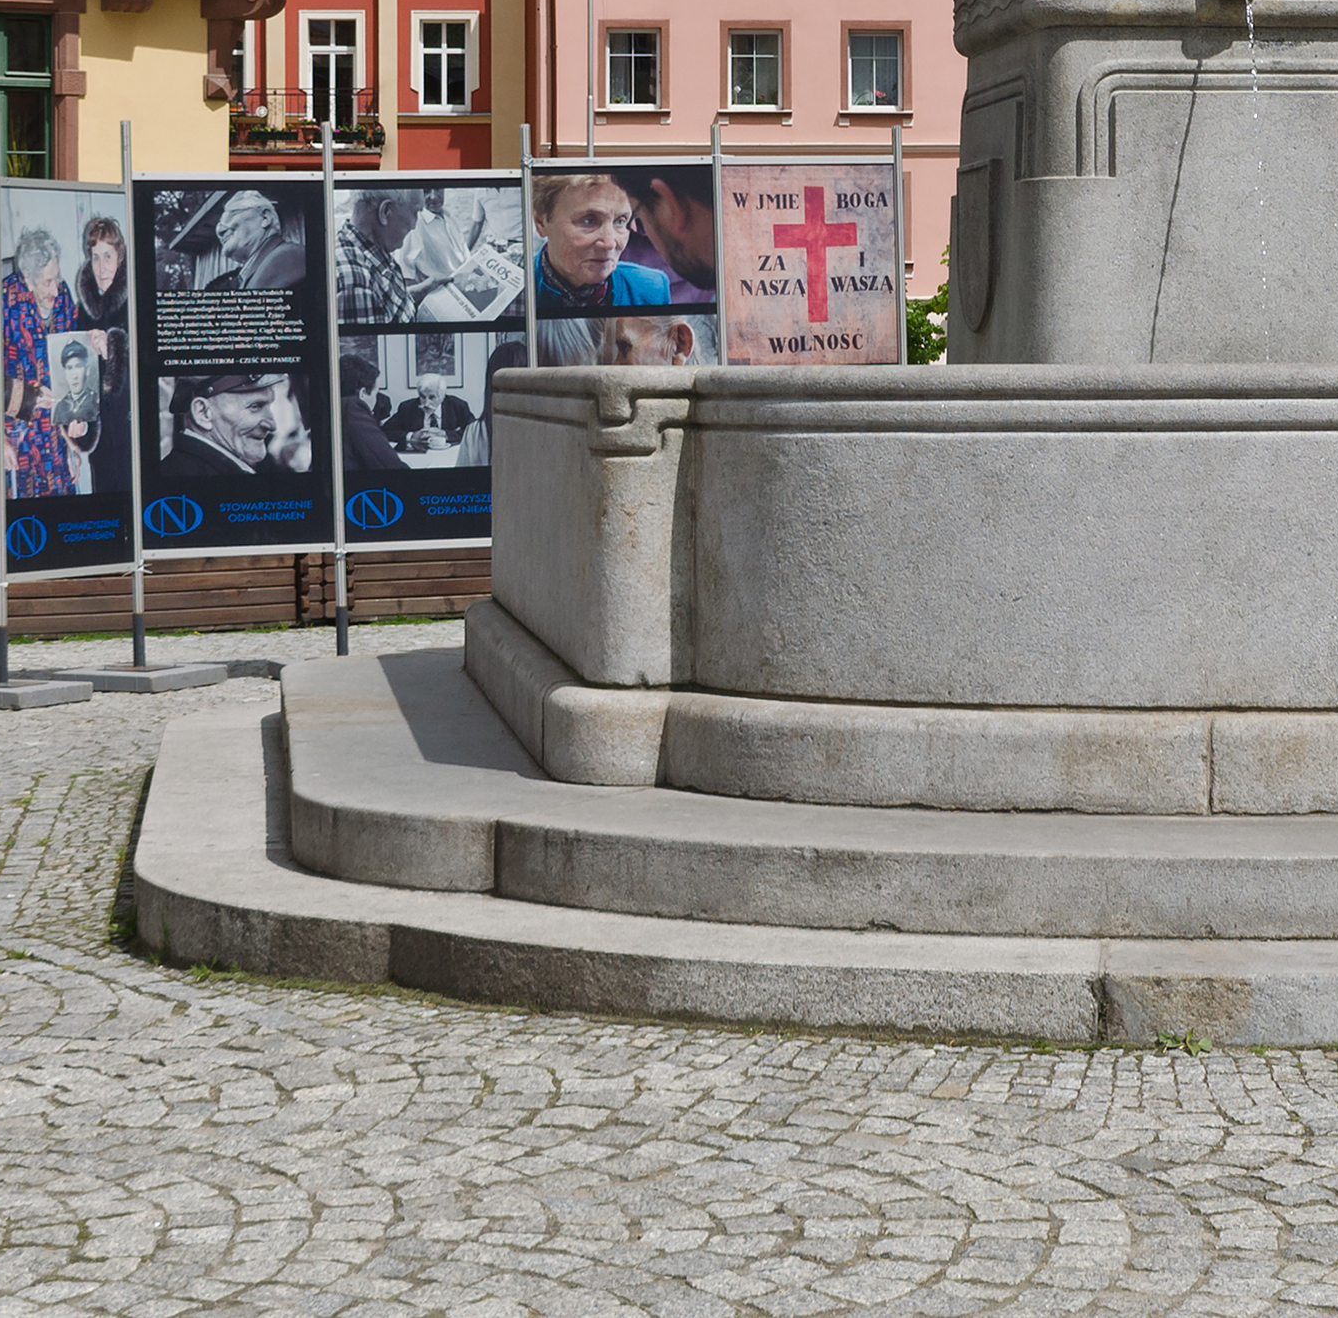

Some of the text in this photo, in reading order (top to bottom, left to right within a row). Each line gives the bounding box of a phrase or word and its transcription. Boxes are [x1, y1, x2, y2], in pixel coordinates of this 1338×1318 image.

[732, 192, 749, 208] W
[836, 192, 888, 209] BOGA
[758, 255, 786, 271] ZA
[859, 252, 865, 267] I
[740, 275, 894, 297] NASZĄ WASZĄ
[219, 500, 312, 512] STOWARZYSZENIE
[228, 511, 305, 523] ODRA-NIEMEN
